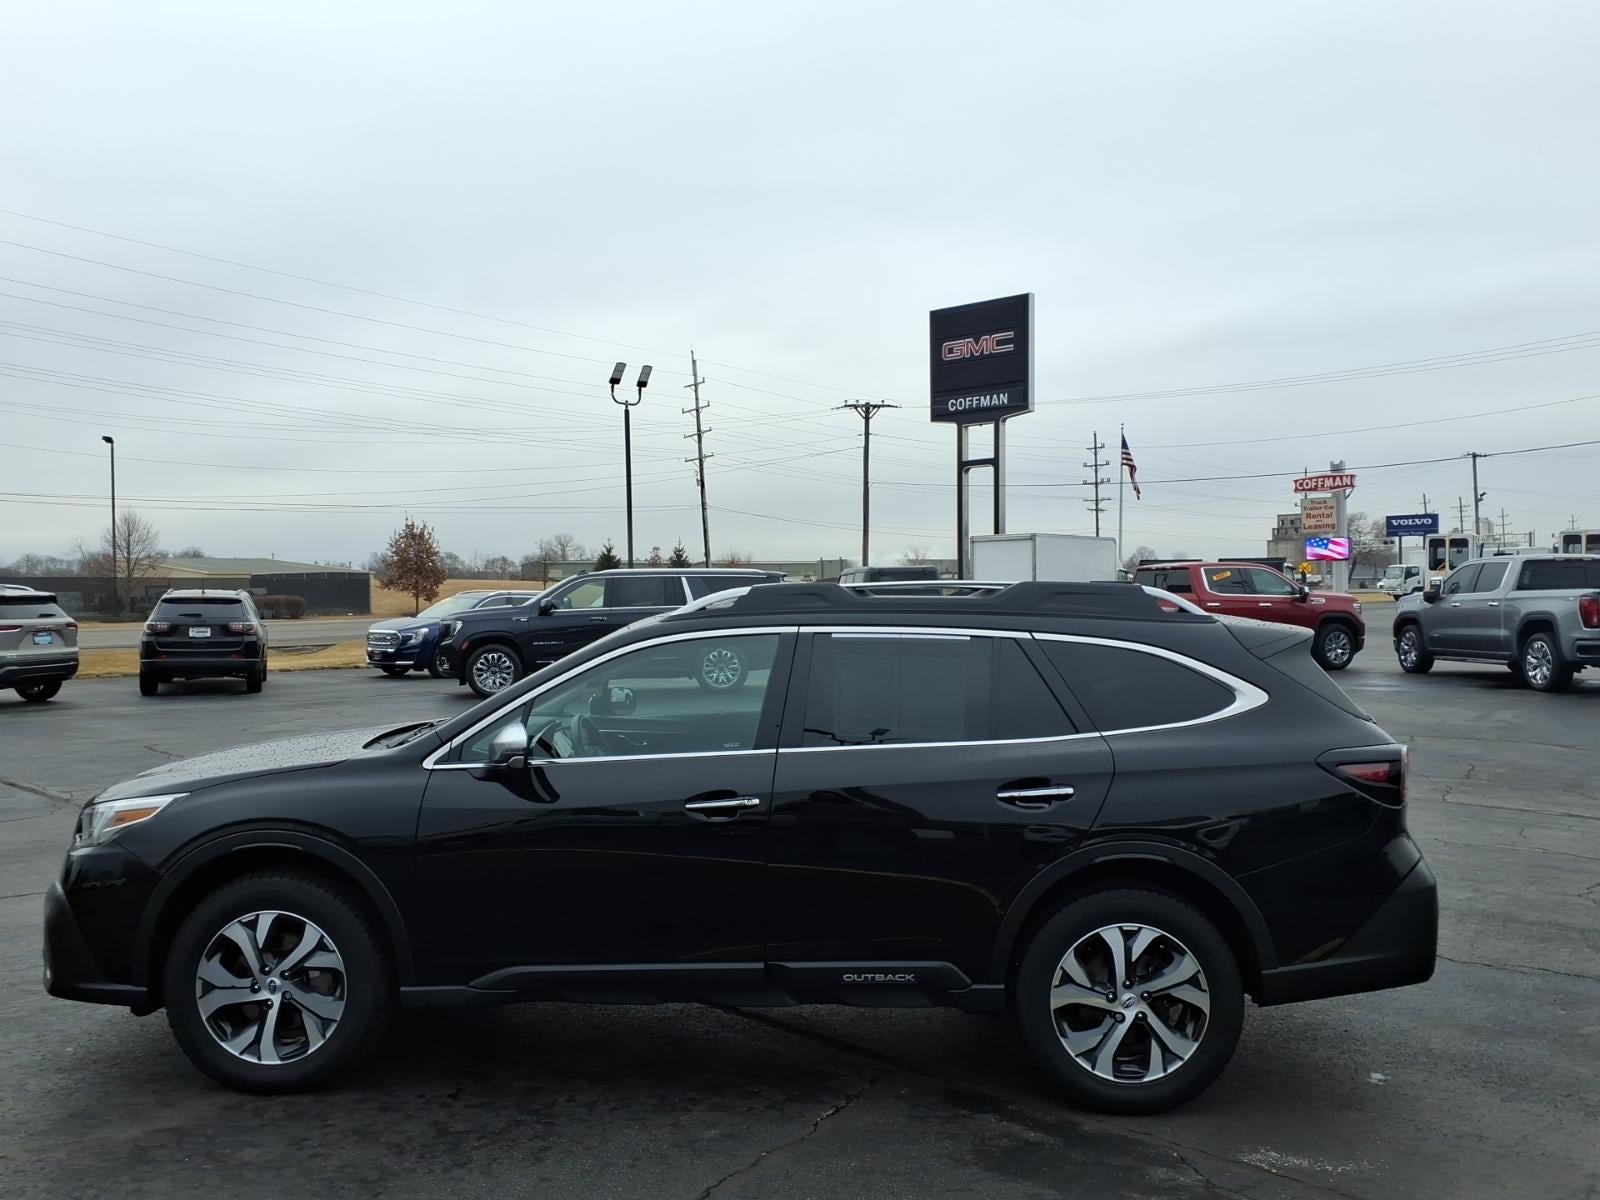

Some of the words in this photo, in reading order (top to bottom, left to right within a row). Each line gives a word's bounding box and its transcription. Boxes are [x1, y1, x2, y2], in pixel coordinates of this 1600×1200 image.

[942, 331, 1014, 361] GMC
[948, 392, 1009, 412] COFFMAN
[1296, 475, 1351, 490] COFFMAN
[1305, 511, 1334, 520] Rental
[1303, 522, 1336, 530] Leasing
[1391, 518, 1432, 526] VOLVO
[843, 973, 916, 982] OUTBACK
